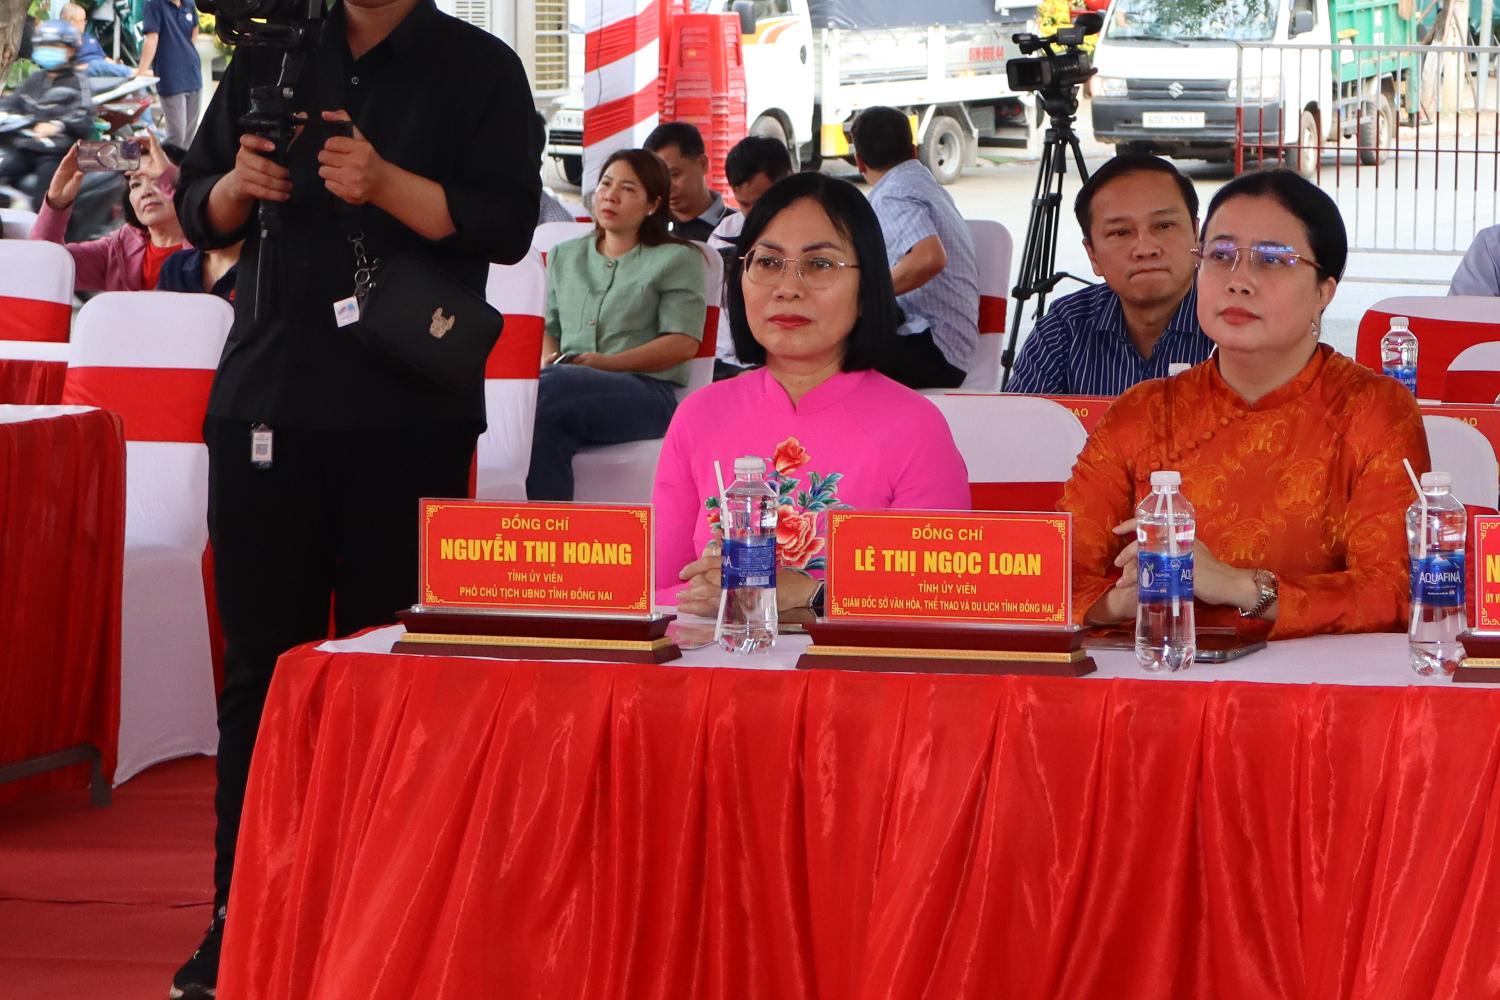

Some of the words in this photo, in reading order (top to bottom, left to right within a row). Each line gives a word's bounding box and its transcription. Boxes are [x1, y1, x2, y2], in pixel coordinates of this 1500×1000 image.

[501, 513, 541, 530] ĐỒNG
[545, 516, 569, 531] CHÍ
[911, 523, 954, 541] ĐỒNG
[958, 526, 984, 541] CHÍ
[440, 533, 517, 562] NGUYỄN
[523, 540, 557, 567] THỊ
[563, 539, 632, 565] HOÀNG
[854, 545, 876, 572] LÊ
[882, 550, 917, 577] THỊ
[923, 551, 982, 578] NGỌC
[988, 552, 1042, 576] LOAN
[507, 569, 527, 582] TỈNH
[529, 569, 541, 582] ỦY
[543, 570, 563, 583] VIÊN
[1418, 571, 1462, 585] AQUAFINA
[459, 584, 477, 597] PHÓ
[479, 584, 498, 597] CHỦ
[500, 587, 520, 600] TỊCH
[522, 588, 546, 599] UBND
[548, 586, 568, 599] TỈNH
[597, 591, 613, 601] NAI
[918, 580, 939, 594] TỈNH
[941, 580, 954, 594] ỦY
[956, 582, 977, 595] VIÊN
[842, 595, 860, 608] GIÁM
[861, 594, 877, 608] ĐỐC
[878, 595, 889, 608] SỞ
[889, 596, 904, 609] VĂN
[924, 595, 938, 610] THỂ
[939, 600, 959, 611] THAO
[960, 598, 970, 611] VÀ
[971, 601, 982, 612] DU
[983, 602, 1000, 614] LỊCH
[1001, 599, 1018, 612] TỈNH
[1041, 603, 1055, 613] NAI
[1485, 590, 1494, 604] ỦY
